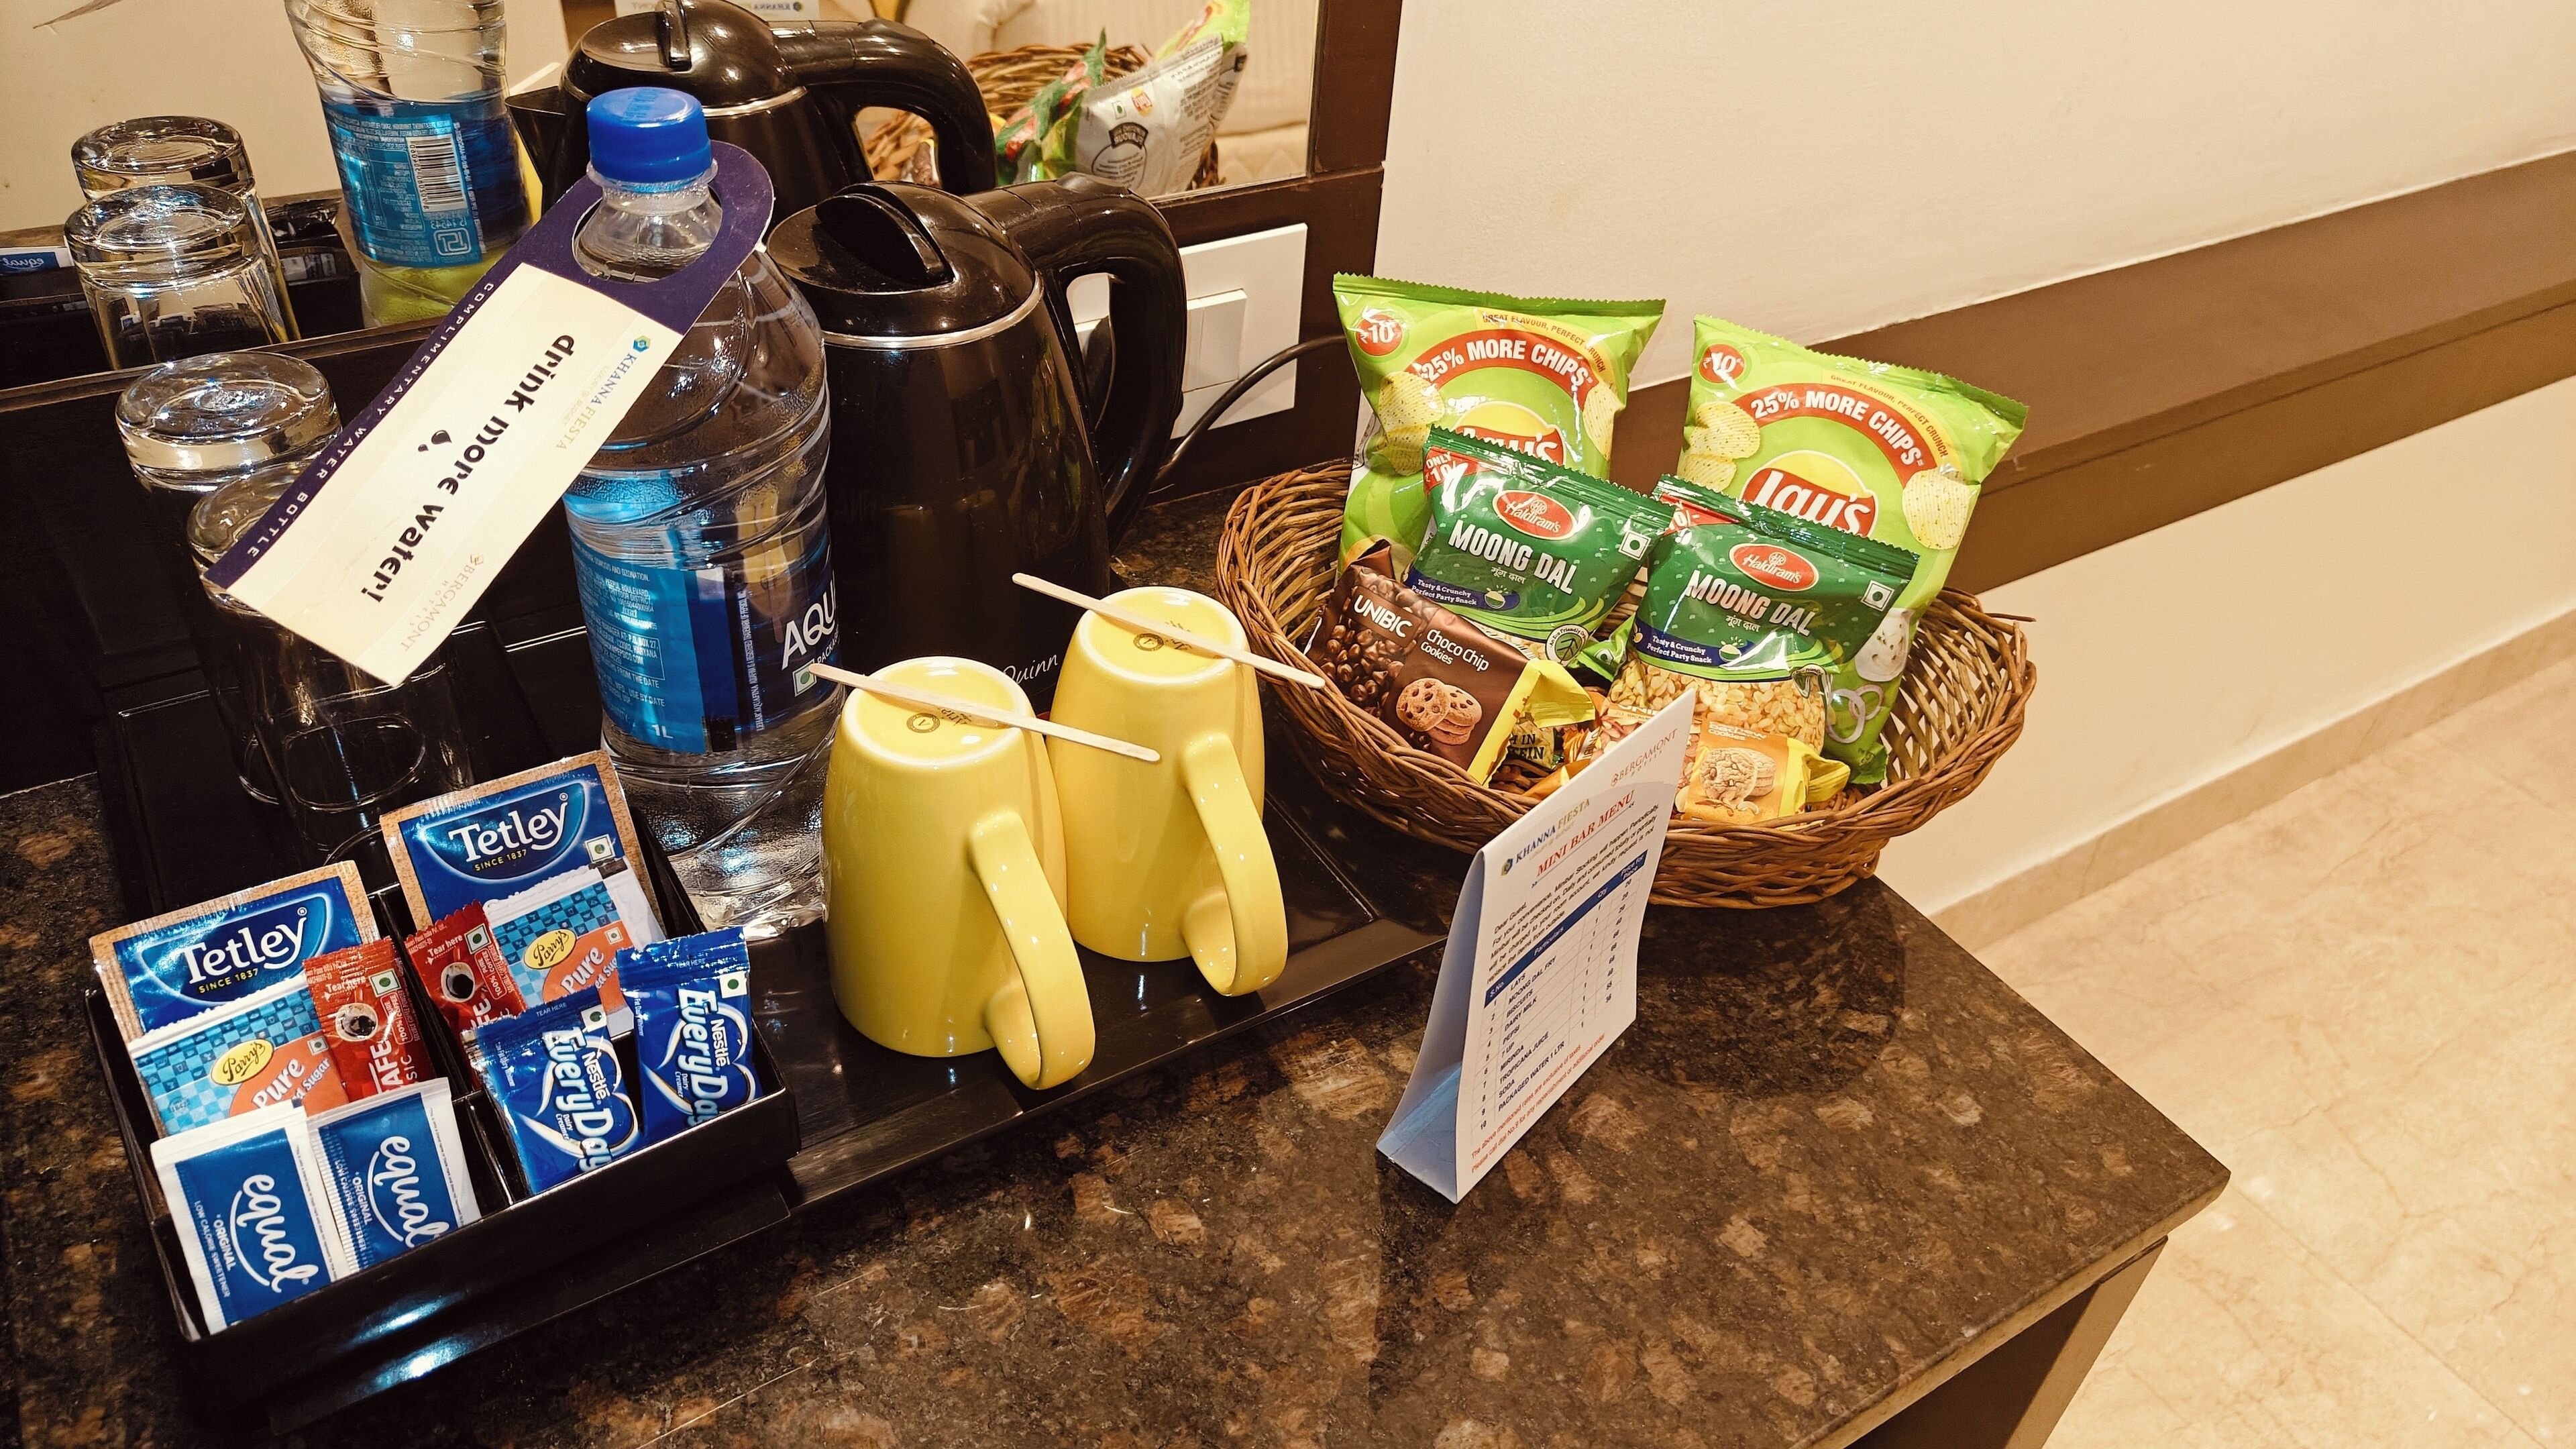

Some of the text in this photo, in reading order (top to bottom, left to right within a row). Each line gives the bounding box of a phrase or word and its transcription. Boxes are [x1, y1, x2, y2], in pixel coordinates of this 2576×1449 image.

[1483, 313, 1509, 324] GREAT
[1551, 327, 1587, 348] PERFECT
[376, 282, 494, 416] COMPLIMENTARY
[1422, 339, 1588, 387] 25% MORE CHIPS
[590, 353, 637, 405] KHANNA
[555, 406, 596, 450] FIESTA
[1750, 390, 1921, 466] 25% MORE CHIPS
[1831, 376, 1856, 388] GREAT
[1898, 400, 1927, 427] PERFECT
[1925, 423, 1949, 458] CRUNCH
[317, 427, 368, 479] WATER
[361, 335, 575, 603] drink more water!
[1426, 451, 1452, 468] ONLY
[247, 492, 309, 558] BOTTLE
[1505, 497, 1561, 533] Haldiram's
[1448, 520, 1578, 594] MOONG DAL
[1491, 564, 1526, 584] मूंग दाल
[1743, 554, 1803, 584] Haldiram's
[1411, 586, 1477, 606] Perfect Party Snack
[1417, 578, 1472, 598] Tasty Crunchy
[1685, 570, 1816, 636] MOONG DAL
[400, 565, 476, 652] BERGAMONT
[782, 580, 837, 670] AQU
[1352, 595, 1413, 639] UNIBIC
[1725, 614, 1760, 633] मूंग दाल
[1420, 641, 1454, 666] Cookies
[1426, 629, 1490, 673] Choco Chip
[1647, 643, 1712, 664] Perfect Party Snack
[1652, 635, 1707, 655] Tasty Crunchy
[632, 673, 660, 689] THE DATE
[751, 685, 762, 712] AQUAFINA
[649, 696, 666, 707] DATE
[651, 724, 674, 739] 1L
[1619, 727, 1677, 781] BERGAMONT
[448, 802, 568, 863] Tetley
[1516, 824, 1556, 863] KHANNA
[1558, 796, 1591, 829] FIESTA
[1537, 844, 1566, 877] MINI
[1570, 821, 1595, 850] BAR
[1598, 789, 1635, 826] MENU
[474, 849, 527, 871] SINCE 1837
[1503, 923, 1515, 938] your
[1575, 852, 1597, 875] Stocking
[1495, 918, 1508, 933] Dear
[1534, 926, 1564, 956] Particulars
[180, 918, 307, 985] Tetley
[427, 945, 445, 956] Tear
[446, 934, 463, 947] here
[532, 930, 571, 966] Parry's
[691, 958, 706, 967] HERE
[198, 968, 260, 994] SINCE 1837
[478, 959, 488, 974] PURE
[482, 951, 495, 976] COFFEE
[559, 947, 605, 994] Pure
[1509, 956, 1556, 1004] MOONG DAL FRY
[1510, 973, 1525, 990] LAYS
[326, 980, 346, 993] Tear
[489, 976, 503, 996] 100%
[1507, 989, 1532, 1017] BISCUITS
[536, 1002, 568, 1016] TEAR HERE
[1504, 996, 1537, 1031] DAIRY MILK
[396, 1018, 408, 1042] 100%
[1503, 1025, 1519, 1044] PEPSI
[222, 1040, 266, 1082] Parry's
[303, 1057, 331, 1093] sugar
[1499, 1030, 1549, 1085] TROPICANA JUICE
[1500, 1044, 1524, 1071] MIRINDA
[252, 1056, 306, 1109] Pure
[542, 1026, 615, 1173] EveryDay
[675, 1071, 684, 1098] Creamer
[1480, 1040, 1564, 1130] 10 PACKAGED WATER LTR
[1499, 1077, 1515, 1098] SODA
[555, 1113, 571, 1140] Creamer
[563, 1114, 574, 1132] Dairy
[352, 1177, 373, 1226] ORIGINAL
[374, 1136, 450, 1248] equal
[339, 1176, 354, 1206] CALORIE
[350, 1207, 367, 1252] SWEETENER
[194, 1200, 231, 1299] LOW CALORIE SWEETENER
[212, 1218, 237, 1271] ORIGINAL
[236, 1174, 319, 1294] equal
